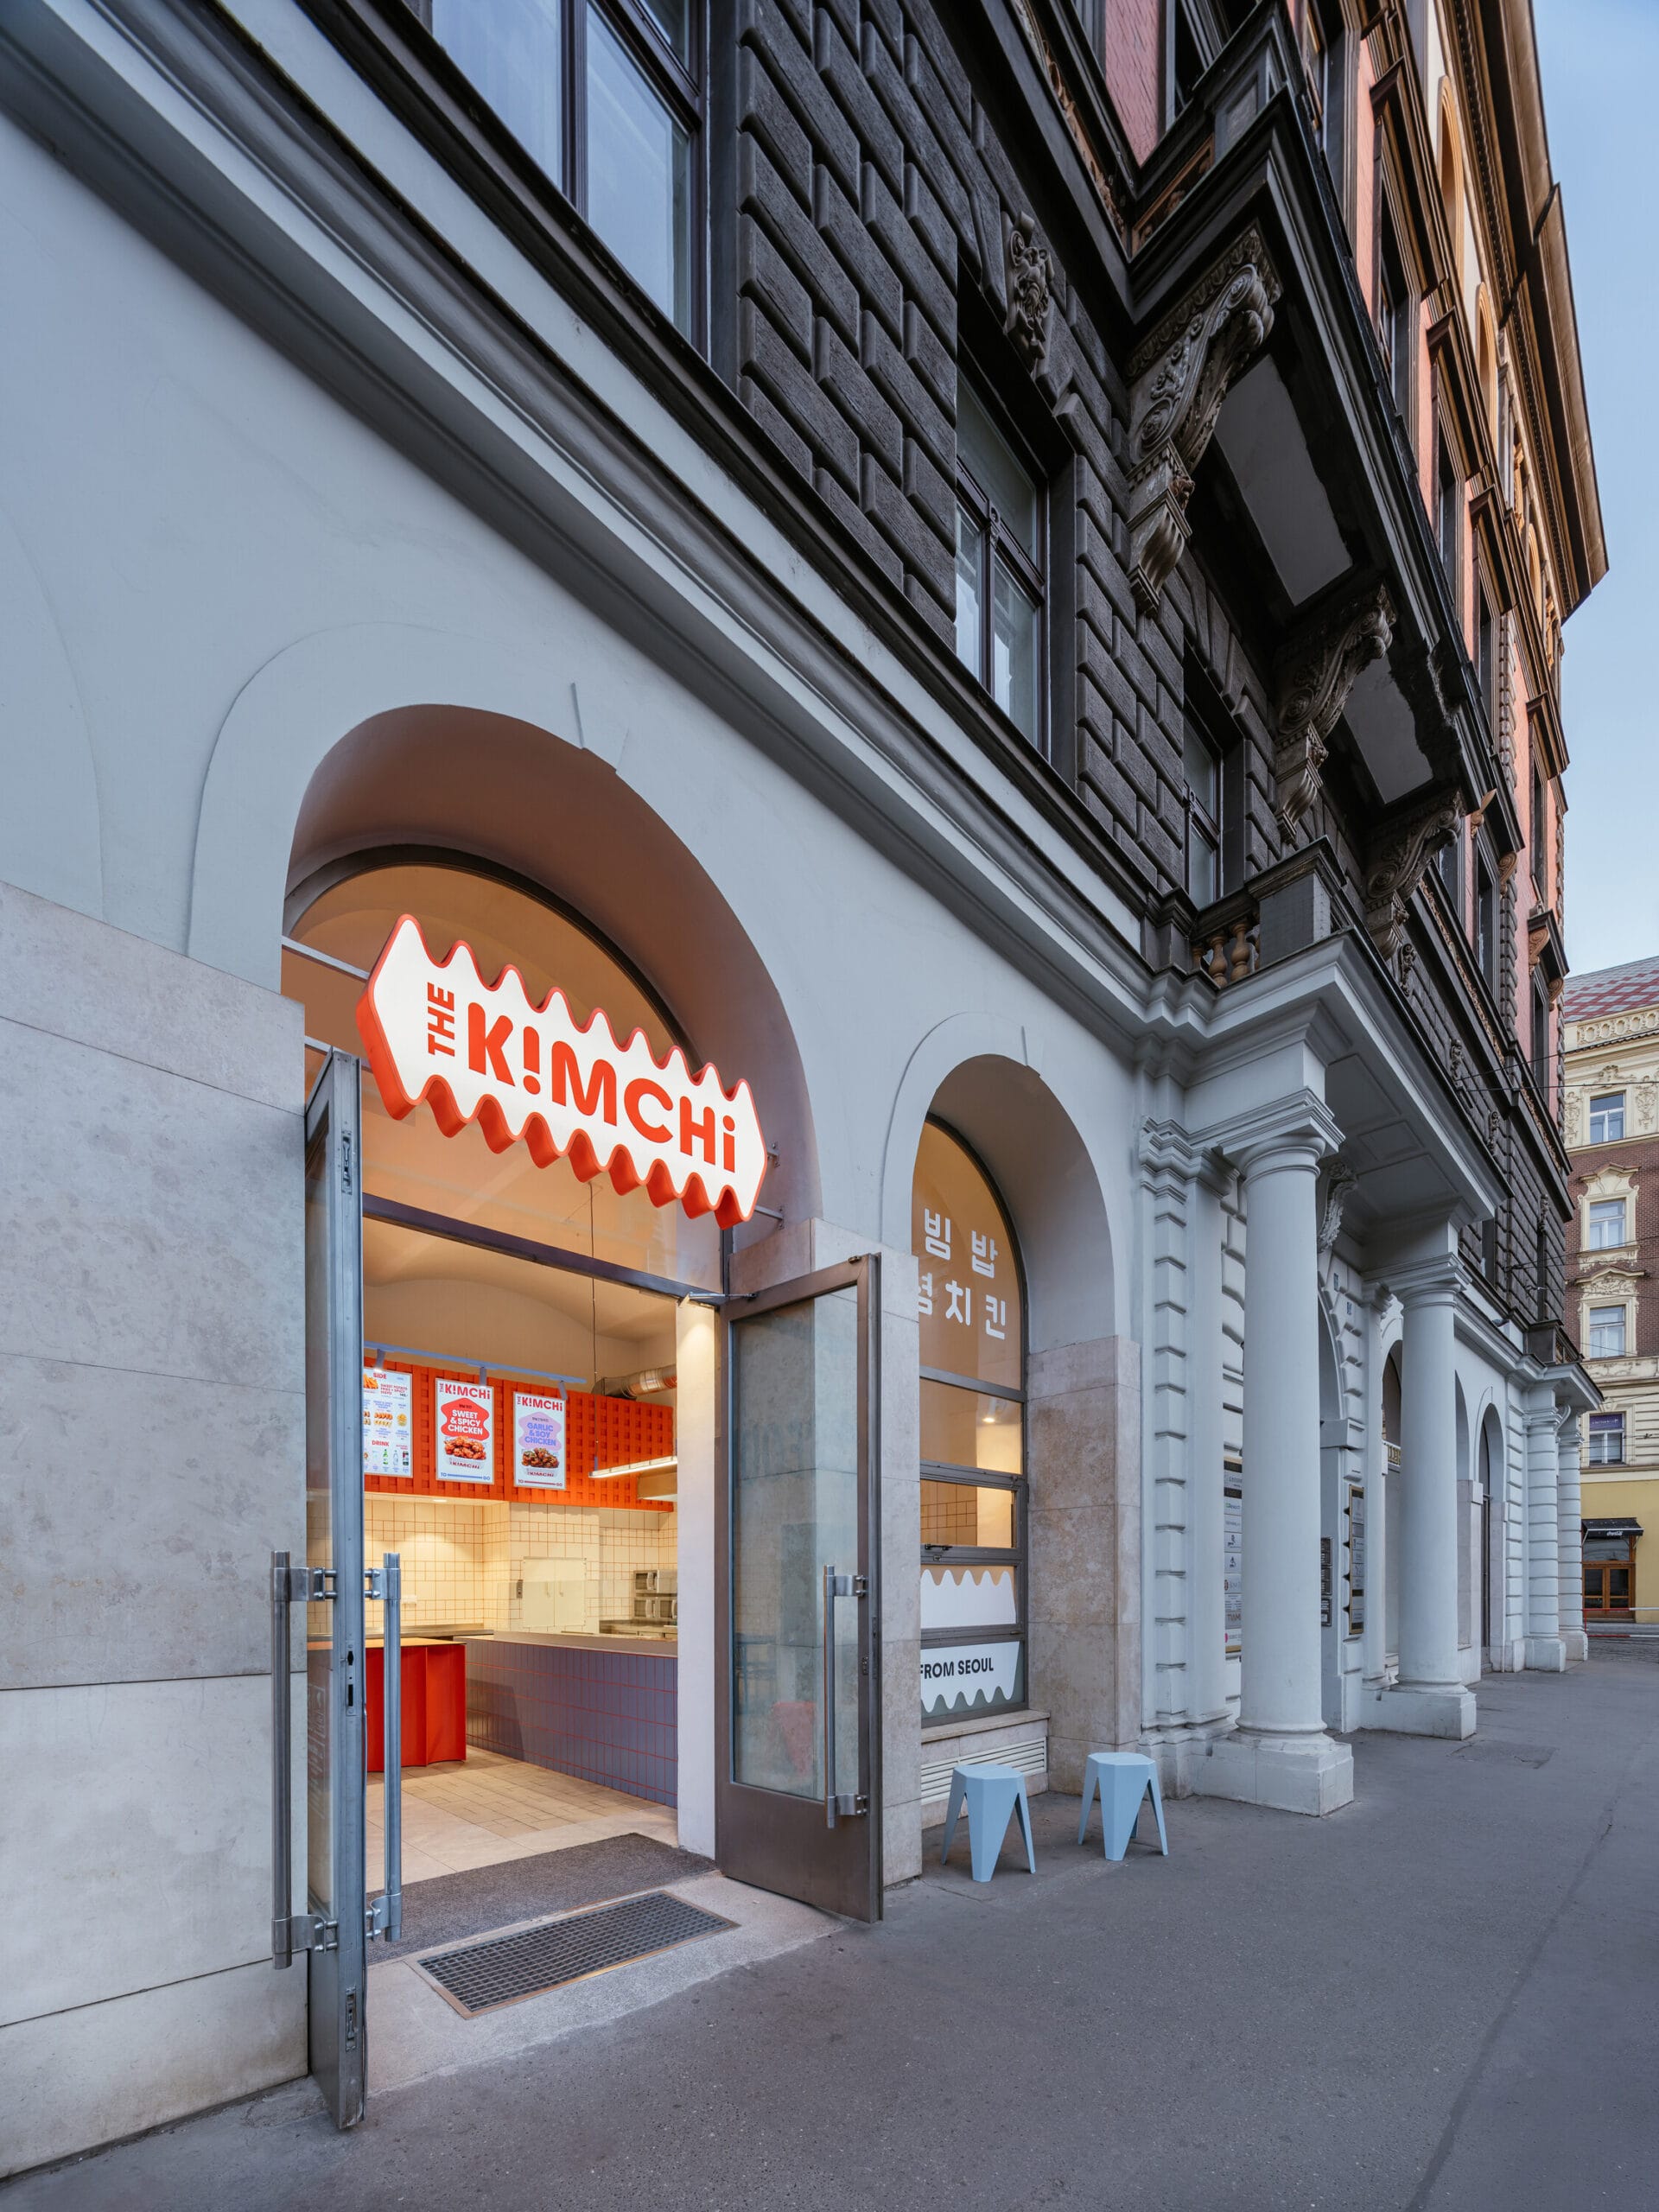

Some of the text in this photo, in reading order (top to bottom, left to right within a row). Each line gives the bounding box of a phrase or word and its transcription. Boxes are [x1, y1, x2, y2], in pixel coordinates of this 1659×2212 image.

[427, 982, 455, 1057] THE
[452, 1409, 478, 1419] SWEET
[450, 1416, 480, 1427] & SPICY
[527, 1422, 554, 1432] GARLIC
[448, 1424, 483, 1435] CHICKEN
[524, 1436, 556, 1446] CHICKEN
[957, 1657, 994, 1675] SEOUL
